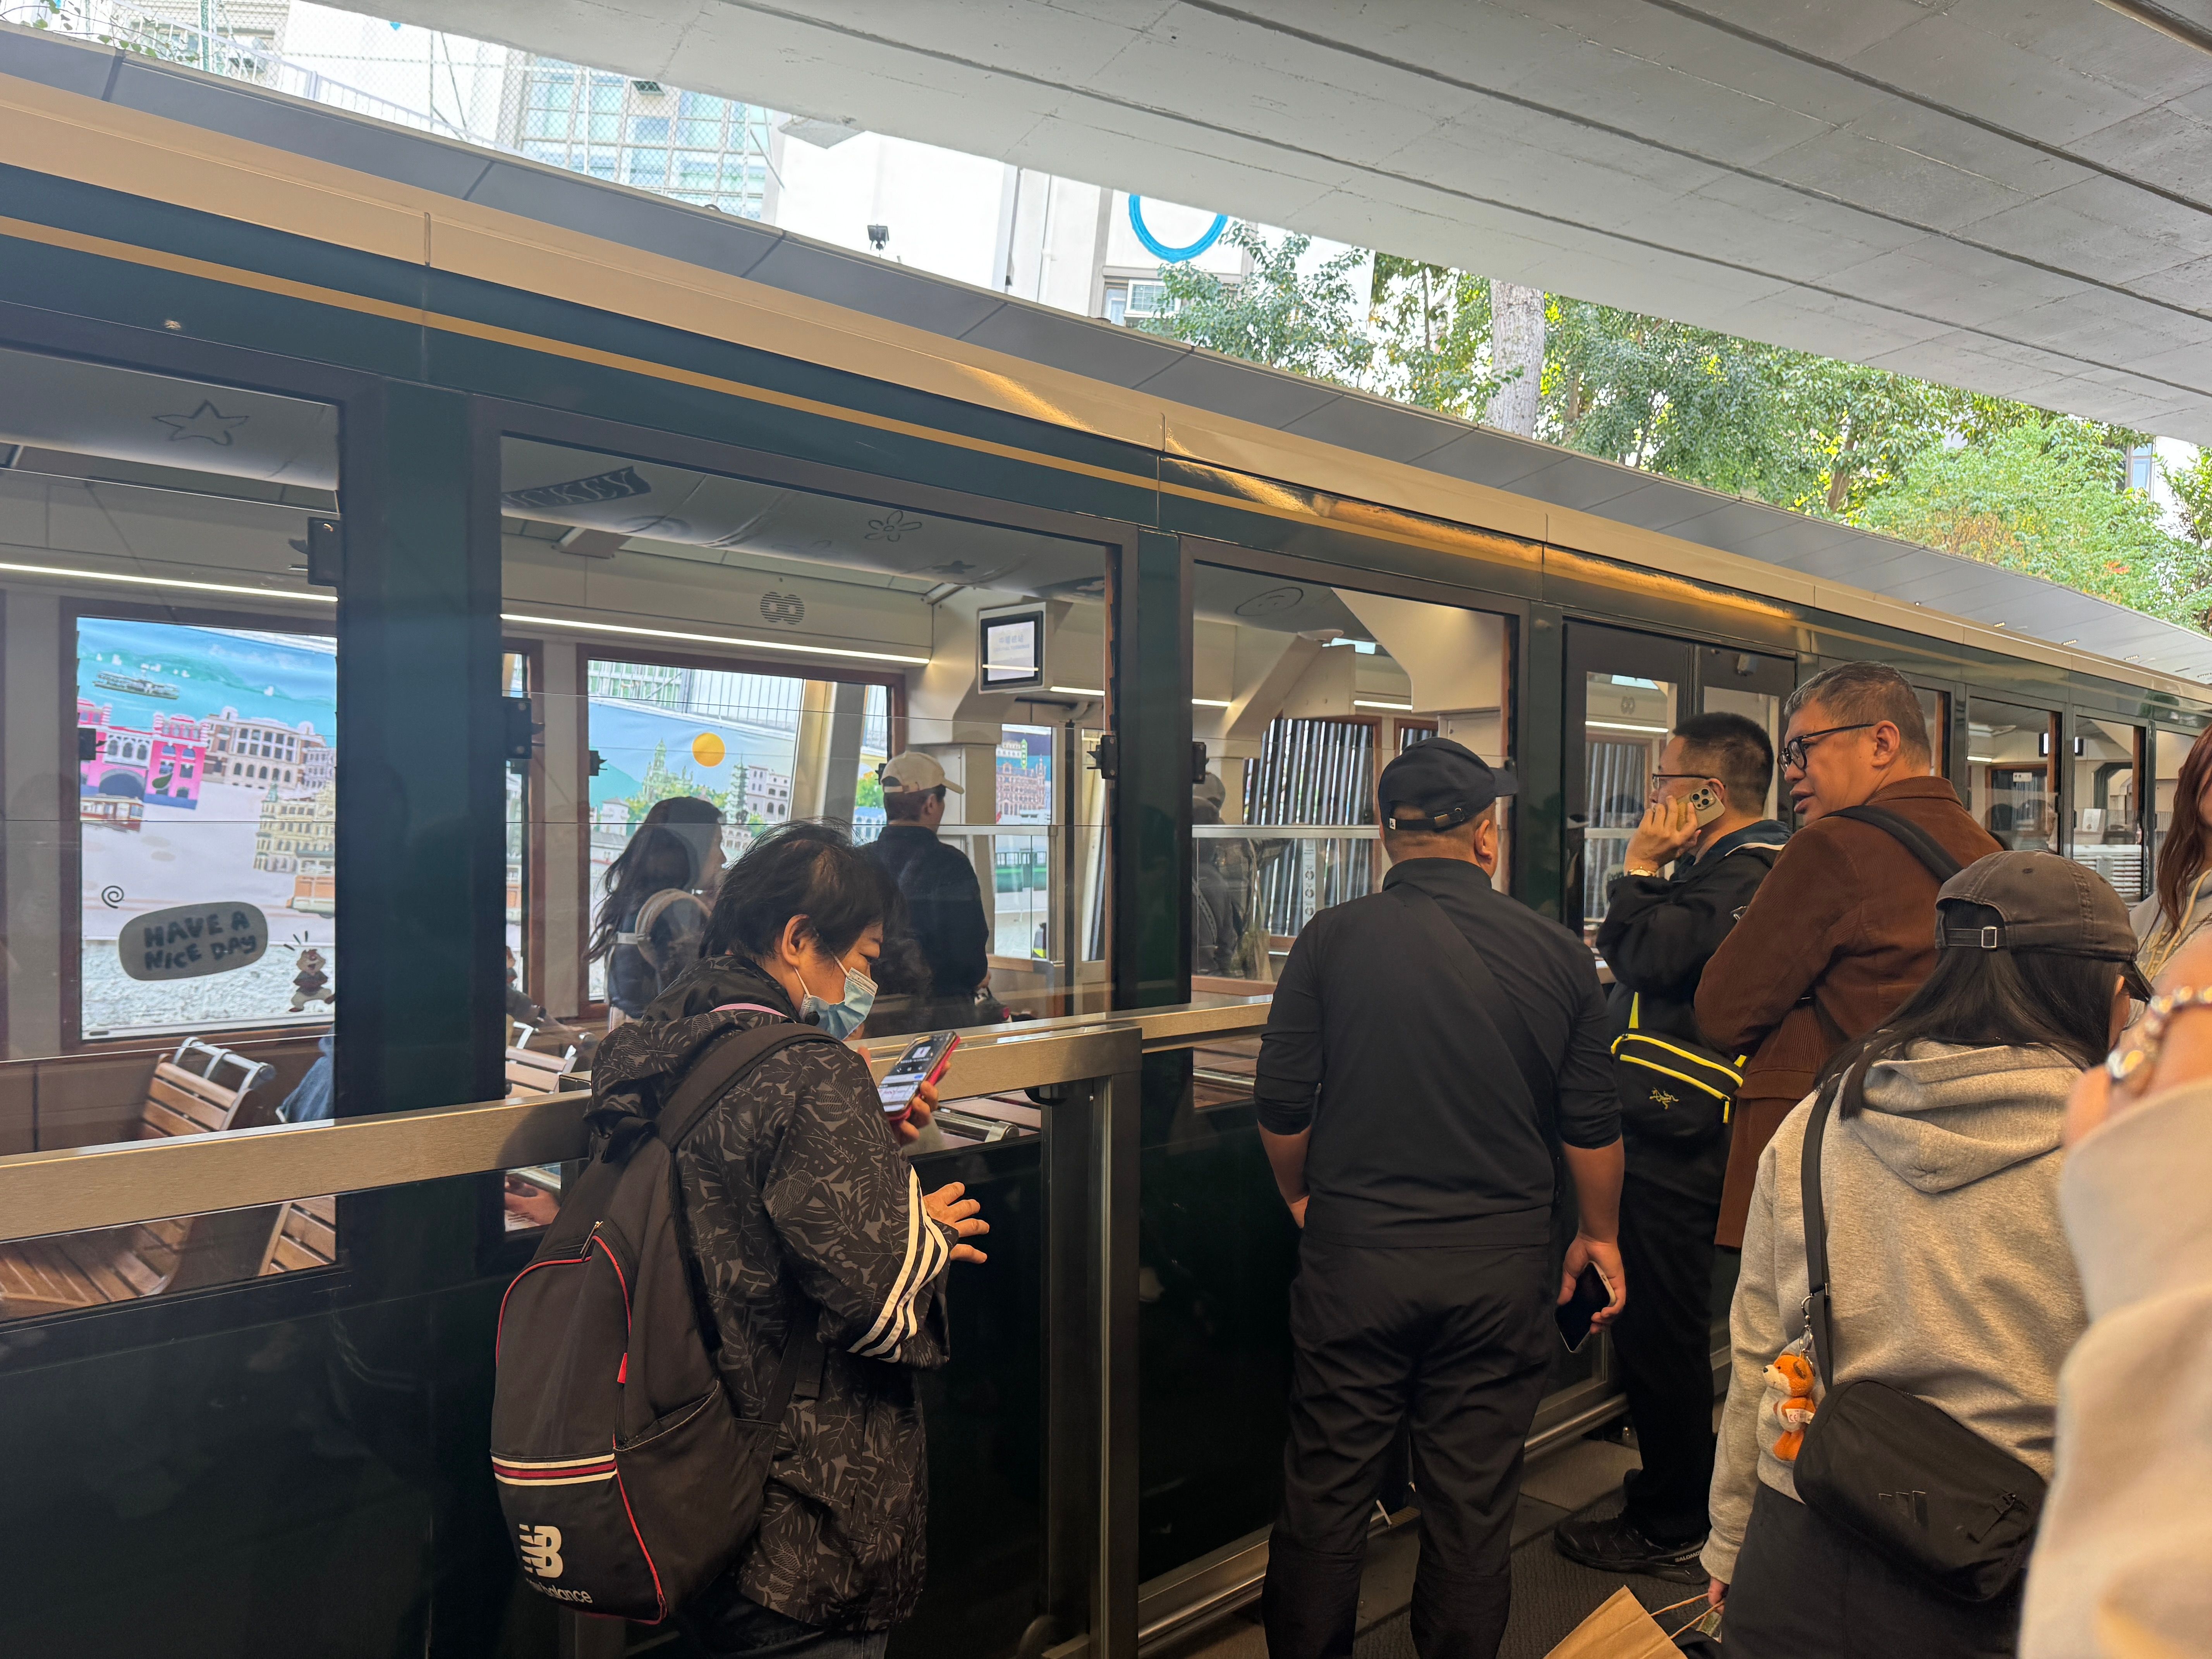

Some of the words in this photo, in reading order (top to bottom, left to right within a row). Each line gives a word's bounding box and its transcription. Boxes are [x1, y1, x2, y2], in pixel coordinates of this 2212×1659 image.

[501, 471, 636, 508] ICKEY
[144, 914, 223, 948] HAVE
[232, 911, 250, 930] A
[144, 943, 202, 970] NICE
[210, 935, 256, 960] DAY
